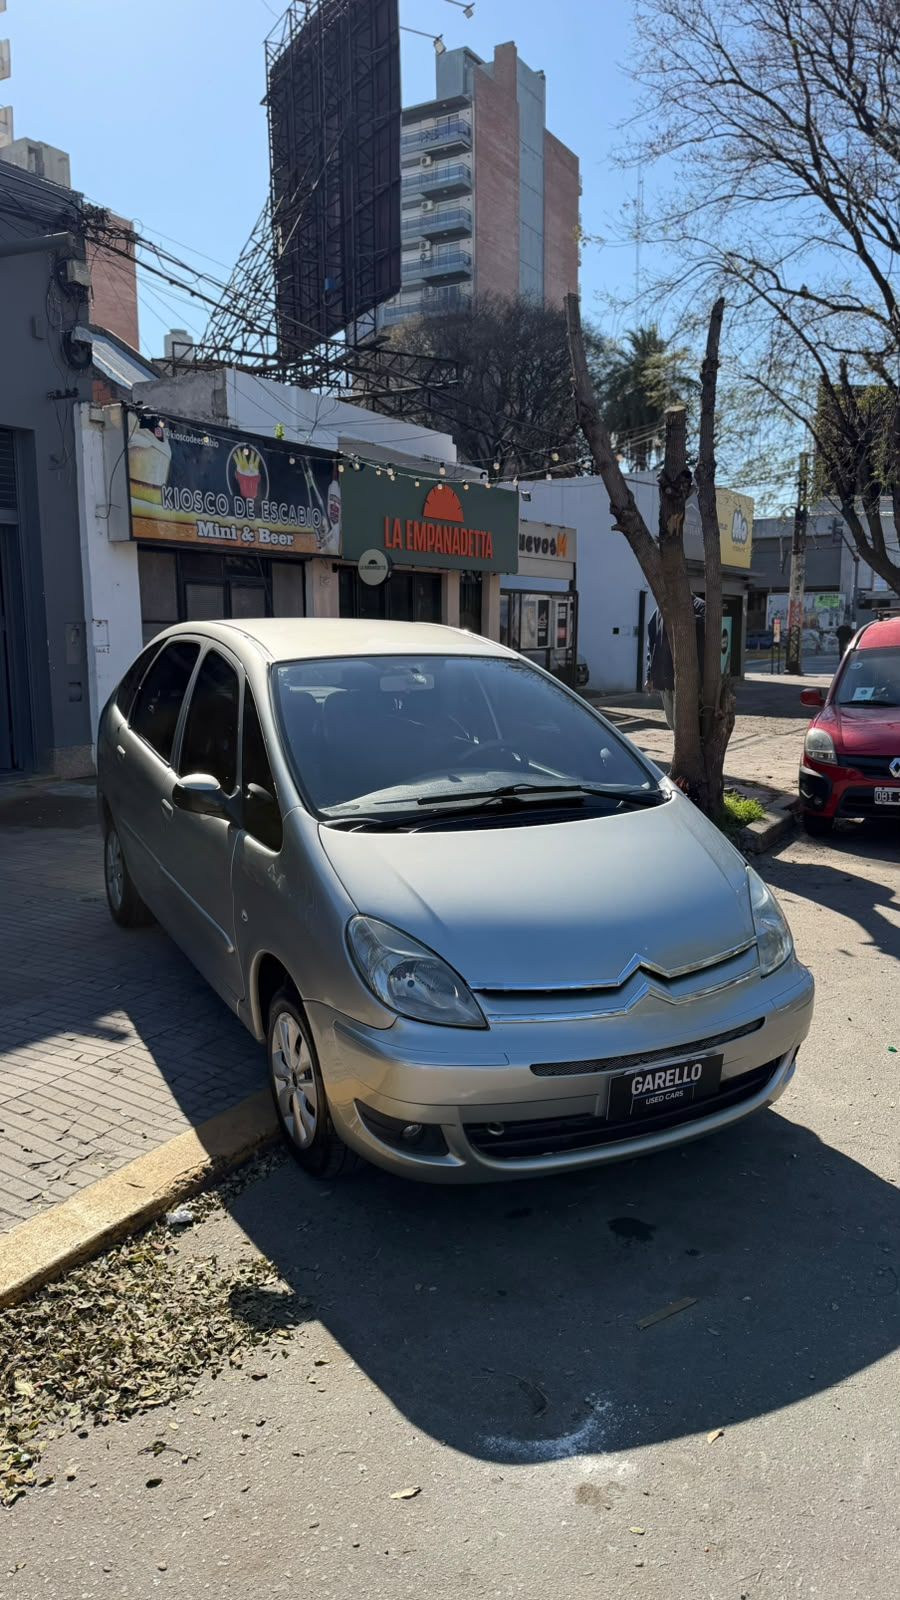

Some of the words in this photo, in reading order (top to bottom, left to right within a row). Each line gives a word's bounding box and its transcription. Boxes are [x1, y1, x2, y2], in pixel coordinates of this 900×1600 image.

[161, 485, 229, 516] KIOSCO
[233, 497, 256, 520] DE
[261, 500, 322, 529] ESCABIO
[197, 520, 238, 541] Mini
[240, 526, 255, 542] &
[258, 527, 294, 546] Beer
[384, 516, 402, 549] LA
[406, 520, 494, 559] EMPANADETTA
[519, 533, 556, 555] uevos
[631, 1063, 703, 1095] GARELLO
[646, 1095, 664, 1105] USED
[665, 1090, 684, 1100] CARS
